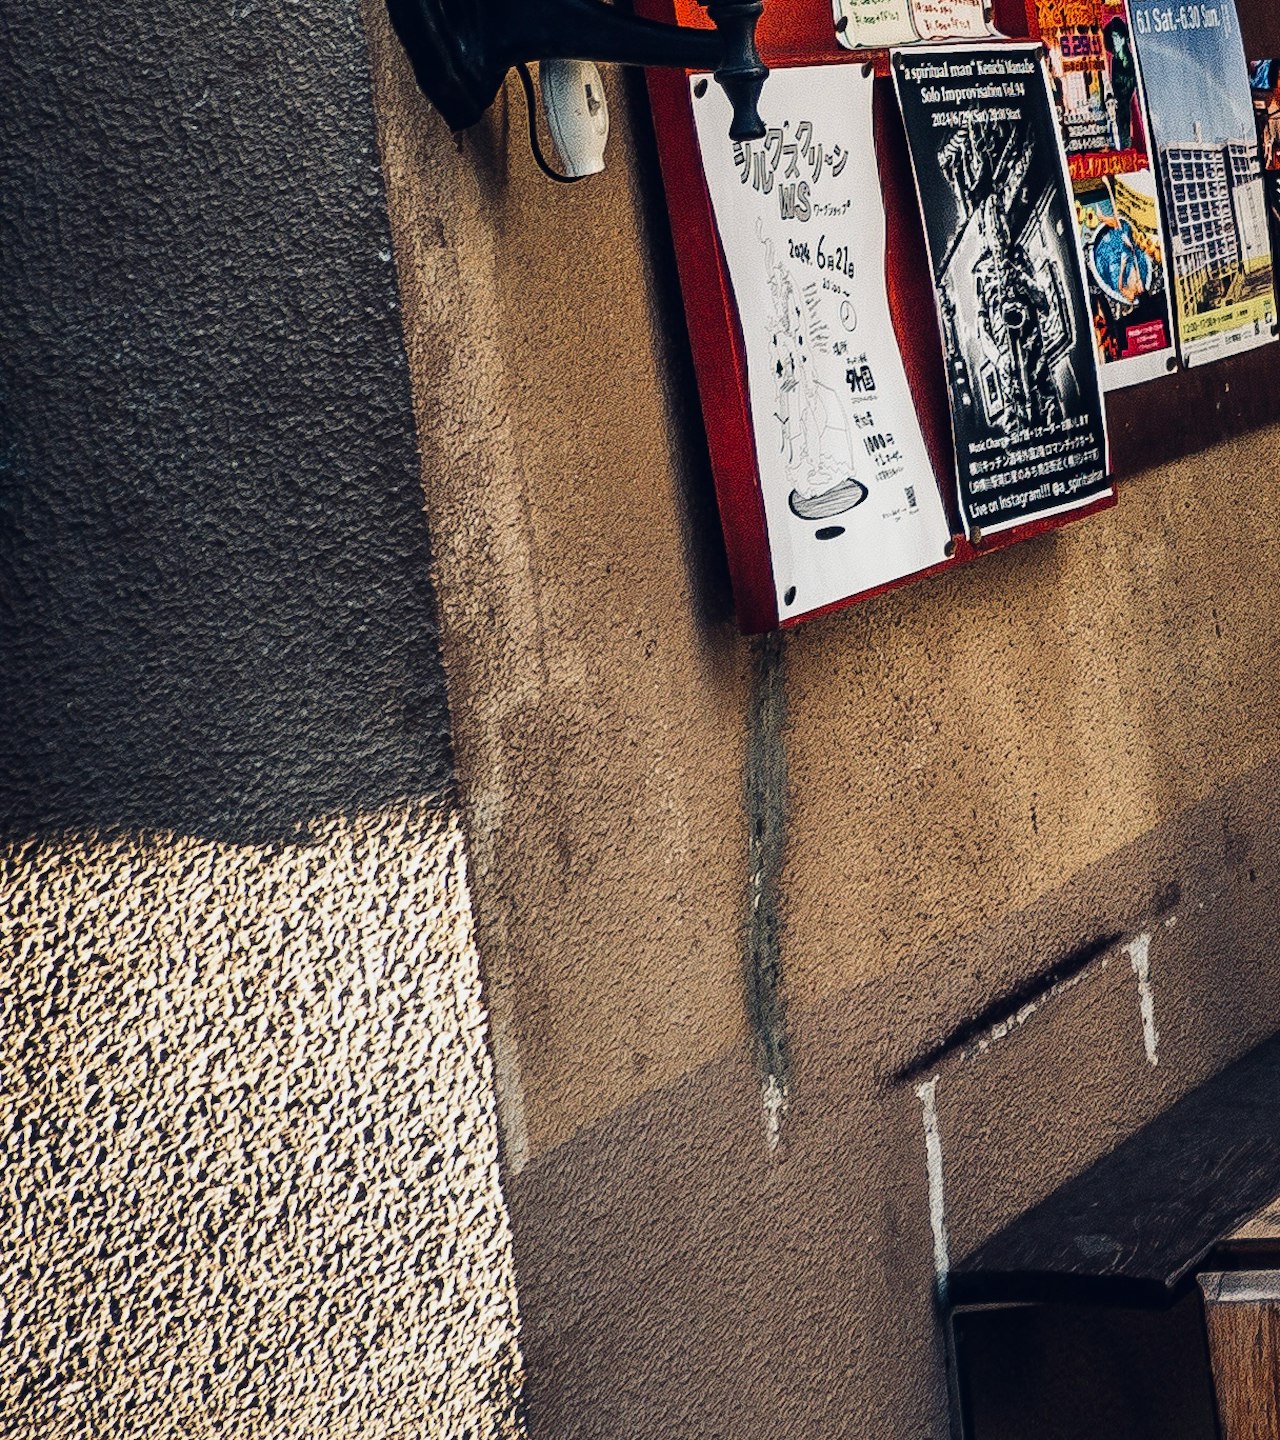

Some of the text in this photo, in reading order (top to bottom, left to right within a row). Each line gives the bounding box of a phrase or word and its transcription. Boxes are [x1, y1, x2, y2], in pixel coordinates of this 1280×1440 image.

[911, 61, 949, 84] spiritual
[920, 86, 940, 104] Solo
[941, 82, 1003, 106] Improvisation
[778, 181, 811, 222] WS
[969, 502, 988, 519] Live
[987, 499, 1000, 514] on
